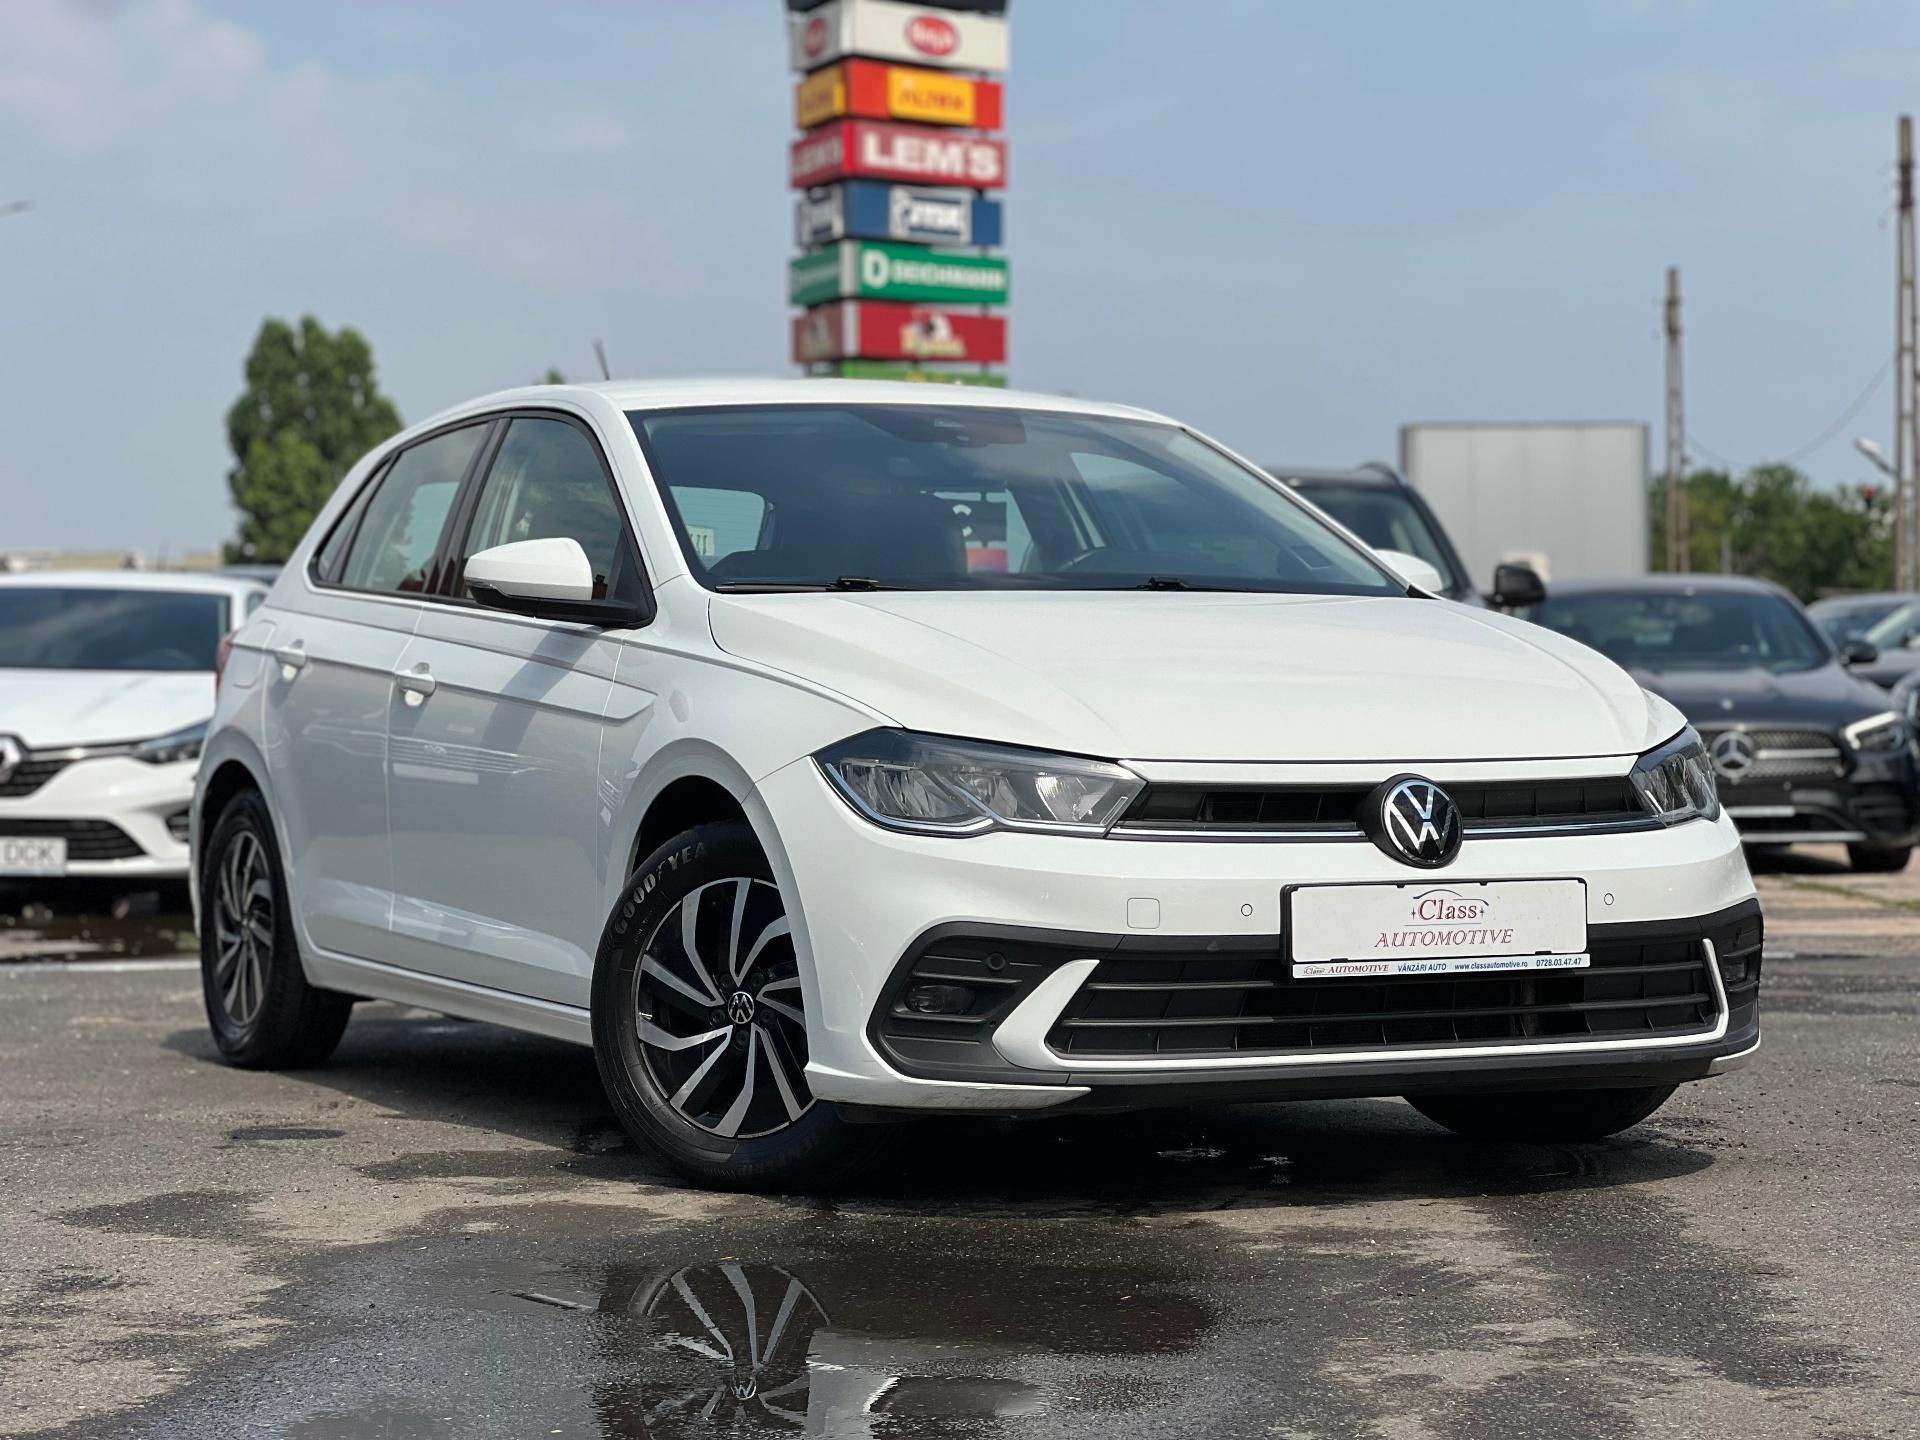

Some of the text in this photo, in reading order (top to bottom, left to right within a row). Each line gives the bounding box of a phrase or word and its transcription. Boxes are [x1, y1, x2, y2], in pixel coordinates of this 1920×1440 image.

[862, 249, 890, 289] D
[1417, 898, 1478, 921] Class
[1374, 928, 1514, 948] AUTOMOTIVE
[1327, 964, 1390, 974] AUTOMOTIVE
[1428, 963, 1447, 971] AUTO
[1454, 960, 1529, 970] www.classautomotive.ro
[1535, 957, 1582, 967] 0728.03.47.47
